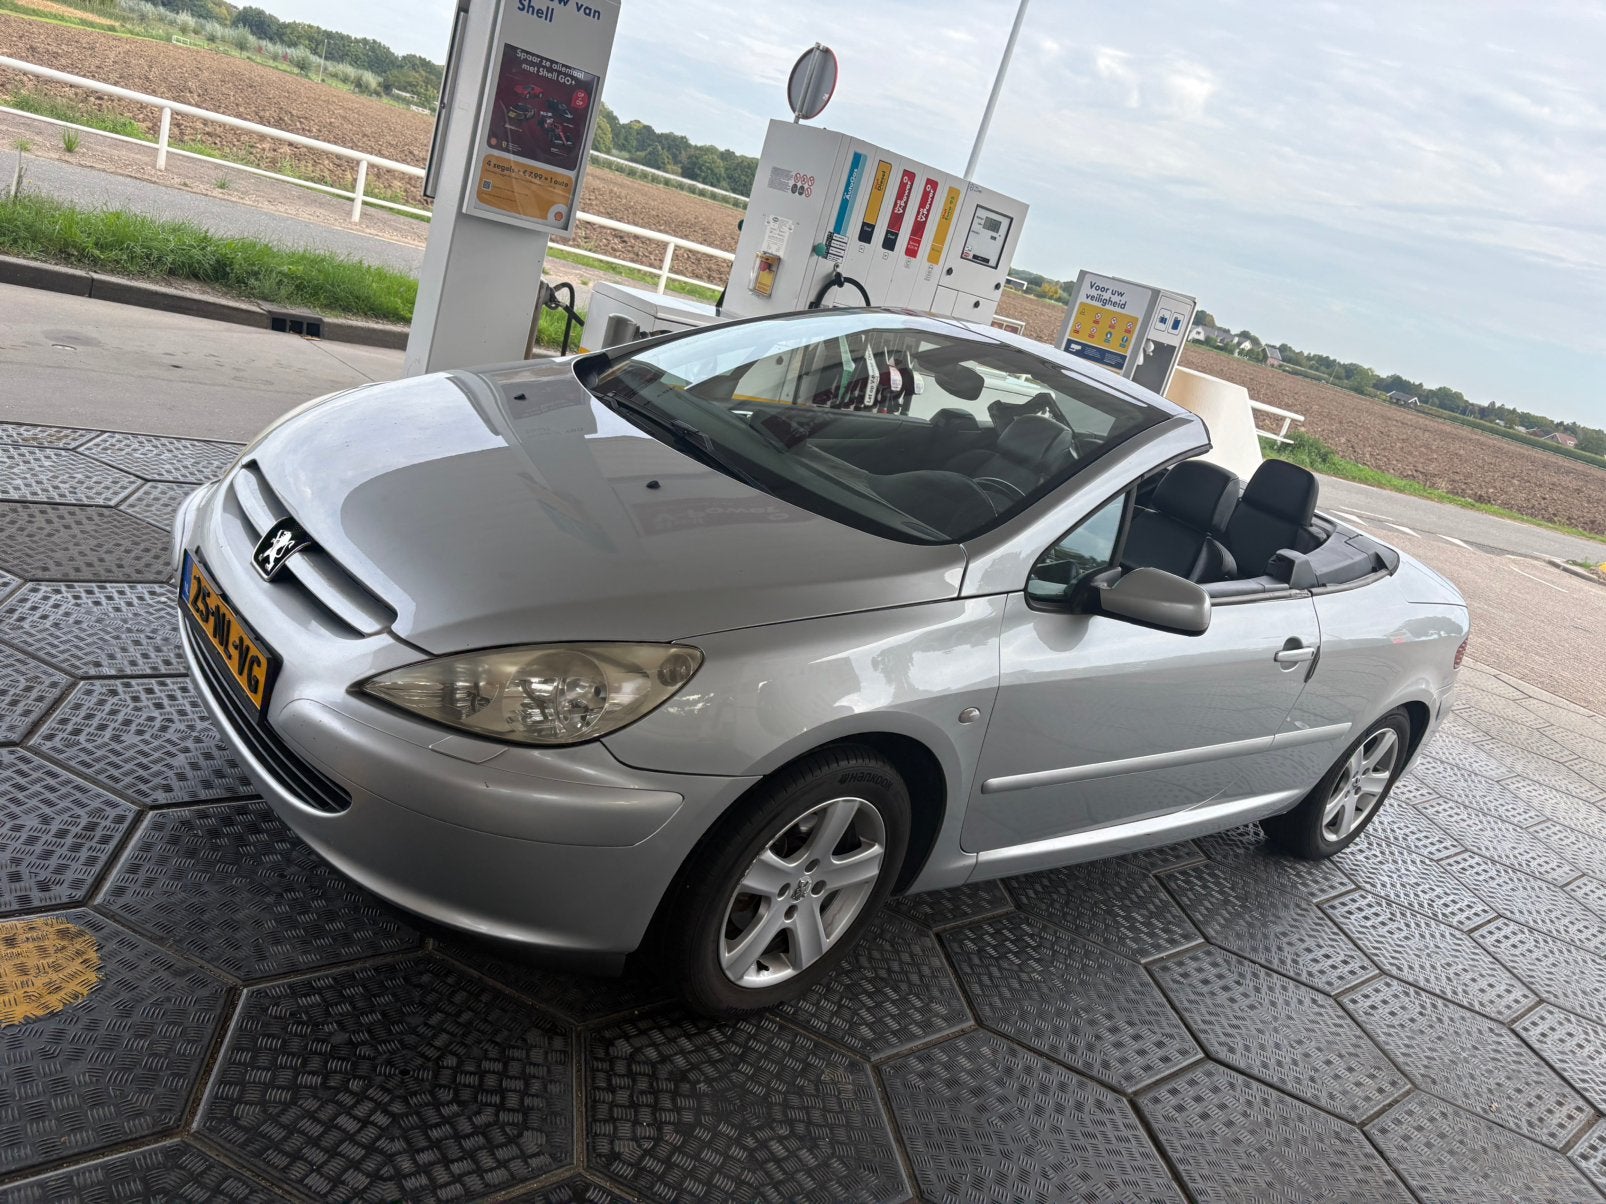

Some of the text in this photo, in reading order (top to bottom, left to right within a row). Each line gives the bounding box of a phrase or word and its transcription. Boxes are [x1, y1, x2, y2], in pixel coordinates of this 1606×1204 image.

[517, 0, 554, 23] Shell
[575, 2, 601, 20] van
[516, 49, 541, 63] Spaar
[552, 62, 585, 79] allemaal
[521, 63, 576, 85] met Shell GO+
[845, 168, 858, 200] AutoGas
[896, 180, 911, 214] V-Power
[919, 189, 934, 222] V-Power
[1089, 281, 1126, 298] Voor uw
[1085, 293, 1127, 310] veiligheid
[191, 574, 262, 695] 25-NL-VG
[848, 771, 894, 791] Hankook
